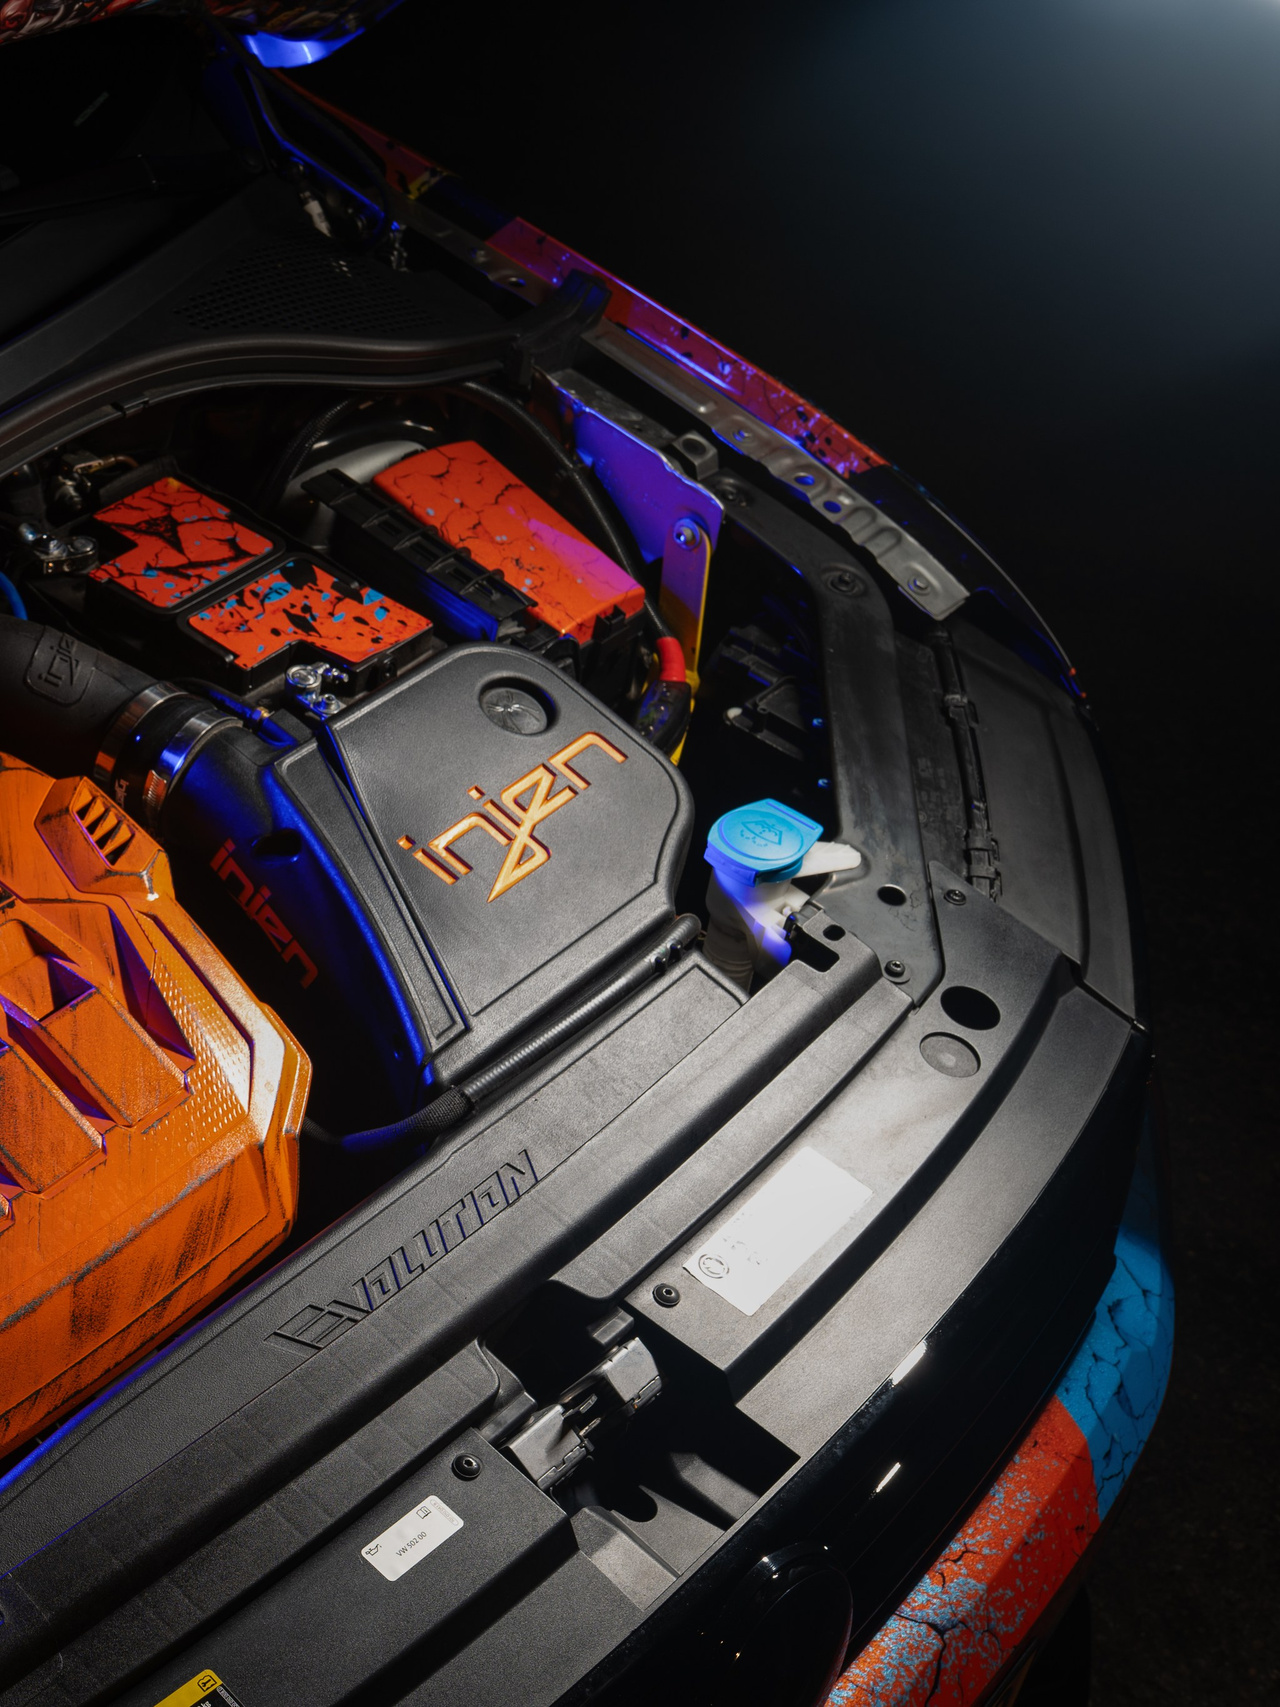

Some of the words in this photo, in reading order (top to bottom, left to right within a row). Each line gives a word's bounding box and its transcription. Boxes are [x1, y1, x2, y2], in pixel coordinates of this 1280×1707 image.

[396, 731, 628, 903] injen
[210, 837, 319, 989] injen
[263, 1149, 539, 1354] EVOLUTION
[396, 1545, 408, 1557] VW
[407, 1538, 419, 1549] 502
[418, 1531, 428, 1541] 00
